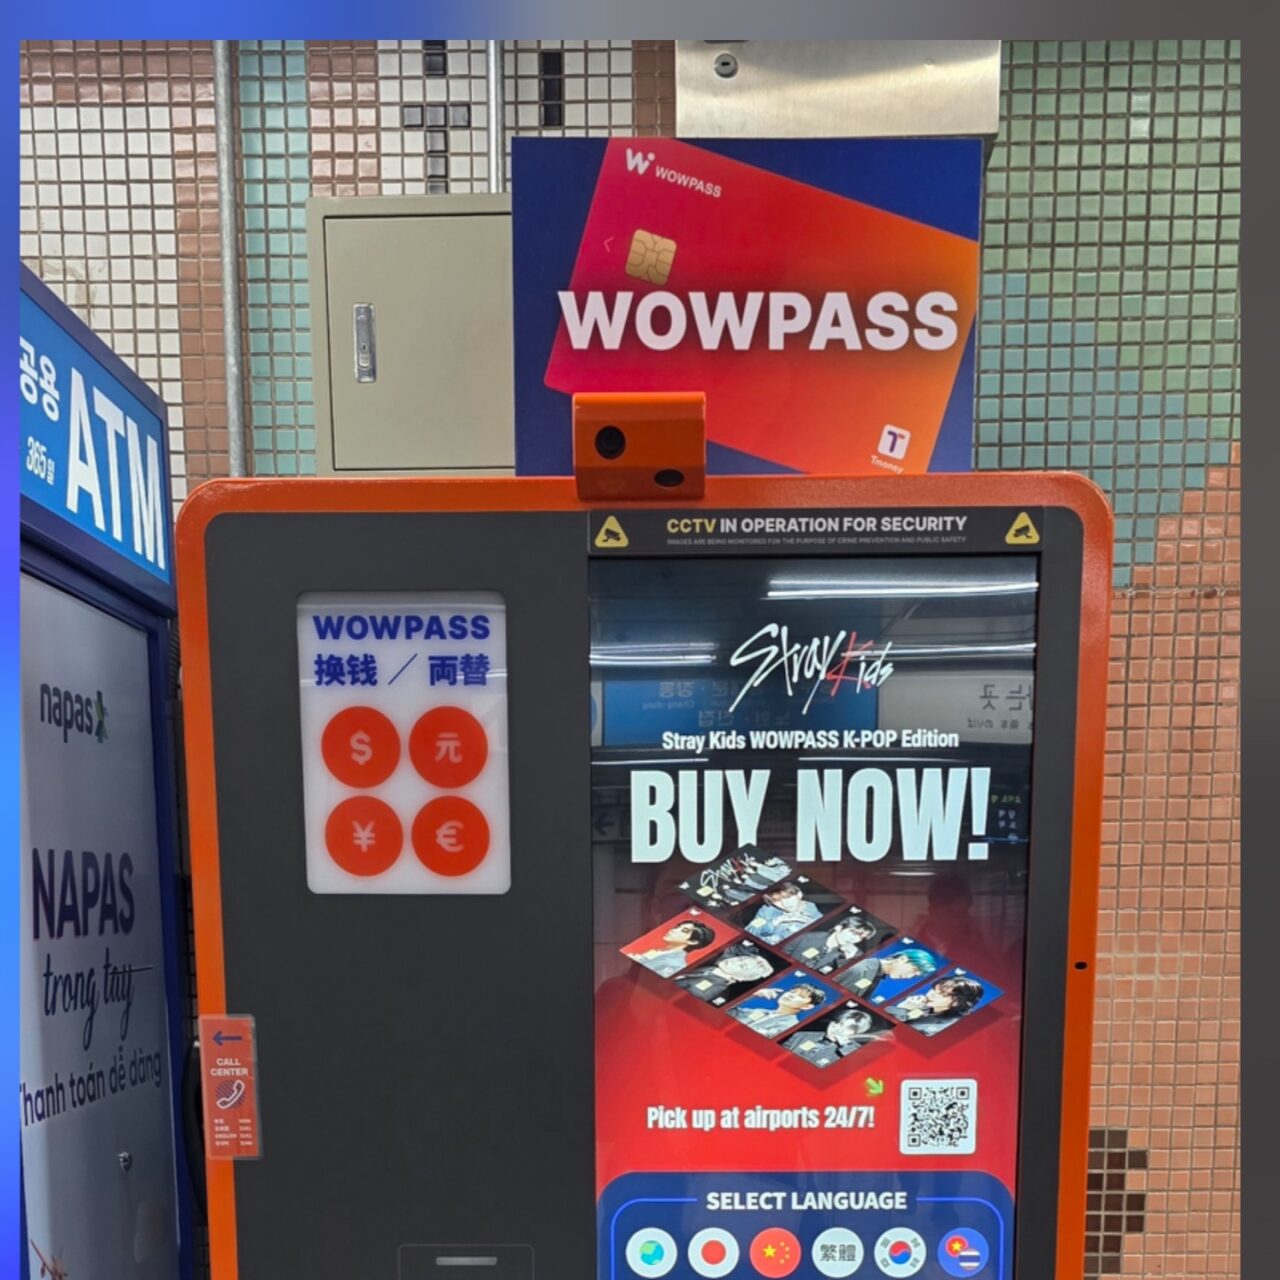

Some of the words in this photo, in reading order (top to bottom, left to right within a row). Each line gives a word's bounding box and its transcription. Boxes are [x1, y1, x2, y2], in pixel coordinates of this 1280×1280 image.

[654, 163, 723, 199] WOWPASS
[557, 290, 959, 352] WOWPASS
[66, 366, 166, 571] ATM
[666, 518, 716, 534] CCTV
[720, 518, 737, 533] IN
[740, 517, 840, 533] OPERATION
[842, 517, 877, 532] FOR
[880, 515, 968, 532] SECURITY
[312, 615, 491, 641] WOWPASS
[314, 653, 378, 687] 换钱
[428, 653, 491, 687] 両替
[728, 622, 847, 716] Stray
[826, 630, 894, 697] Kids
[39, 682, 94, 744] napas
[435, 732, 463, 764] 元
[662, 732, 706, 754] Stray
[709, 731, 746, 750] Kids
[750, 731, 839, 749] WOWPASS
[843, 730, 898, 748] K-POP
[902, 729, 960, 748] Edition
[629, 769, 771, 865] BUY
[796, 767, 992, 863] NOW!
[32, 847, 136, 940] NAPAS
[43, 952, 99, 1051] trong
[103, 946, 154, 1041] tay
[69, 1061, 106, 1110] toán
[130, 1046, 162, 1089] dàng
[210, 1067, 249, 1077] CENTER
[216, 1058, 241, 1066] CALL
[646, 1106, 688, 1129] Pick
[691, 1108, 716, 1131] up
[719, 1107, 740, 1129] at
[743, 1105, 820, 1132] airports
[823, 1106, 875, 1128] 24/7!
[706, 1191, 786, 1210] SELECT
[790, 1190, 908, 1210] LANGUAGE
